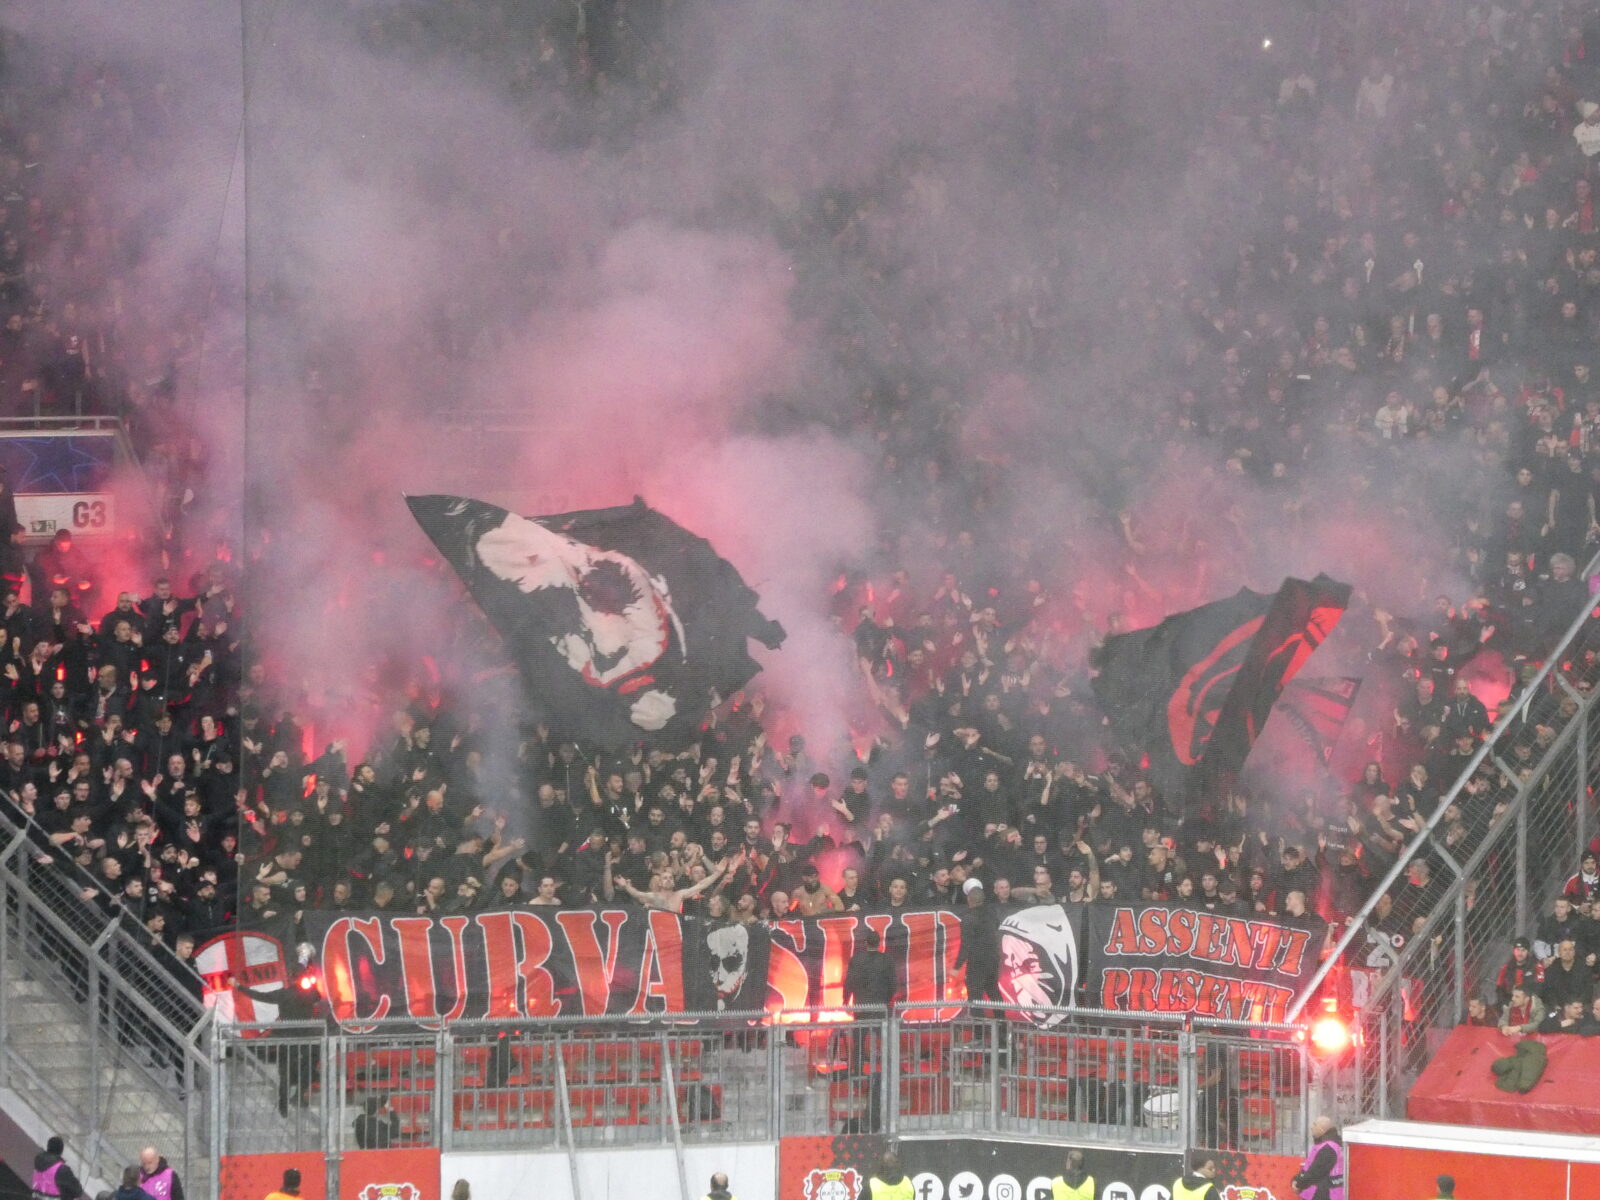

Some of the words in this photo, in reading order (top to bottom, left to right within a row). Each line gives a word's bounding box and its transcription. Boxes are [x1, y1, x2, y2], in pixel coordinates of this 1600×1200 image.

[73, 501, 106, 528] G3
[321, 909, 699, 1034] CURVA
[747, 911, 969, 1026] SUD
[1103, 907, 1311, 976] ASSENTI
[1101, 968, 1294, 1024] PRESENTI
